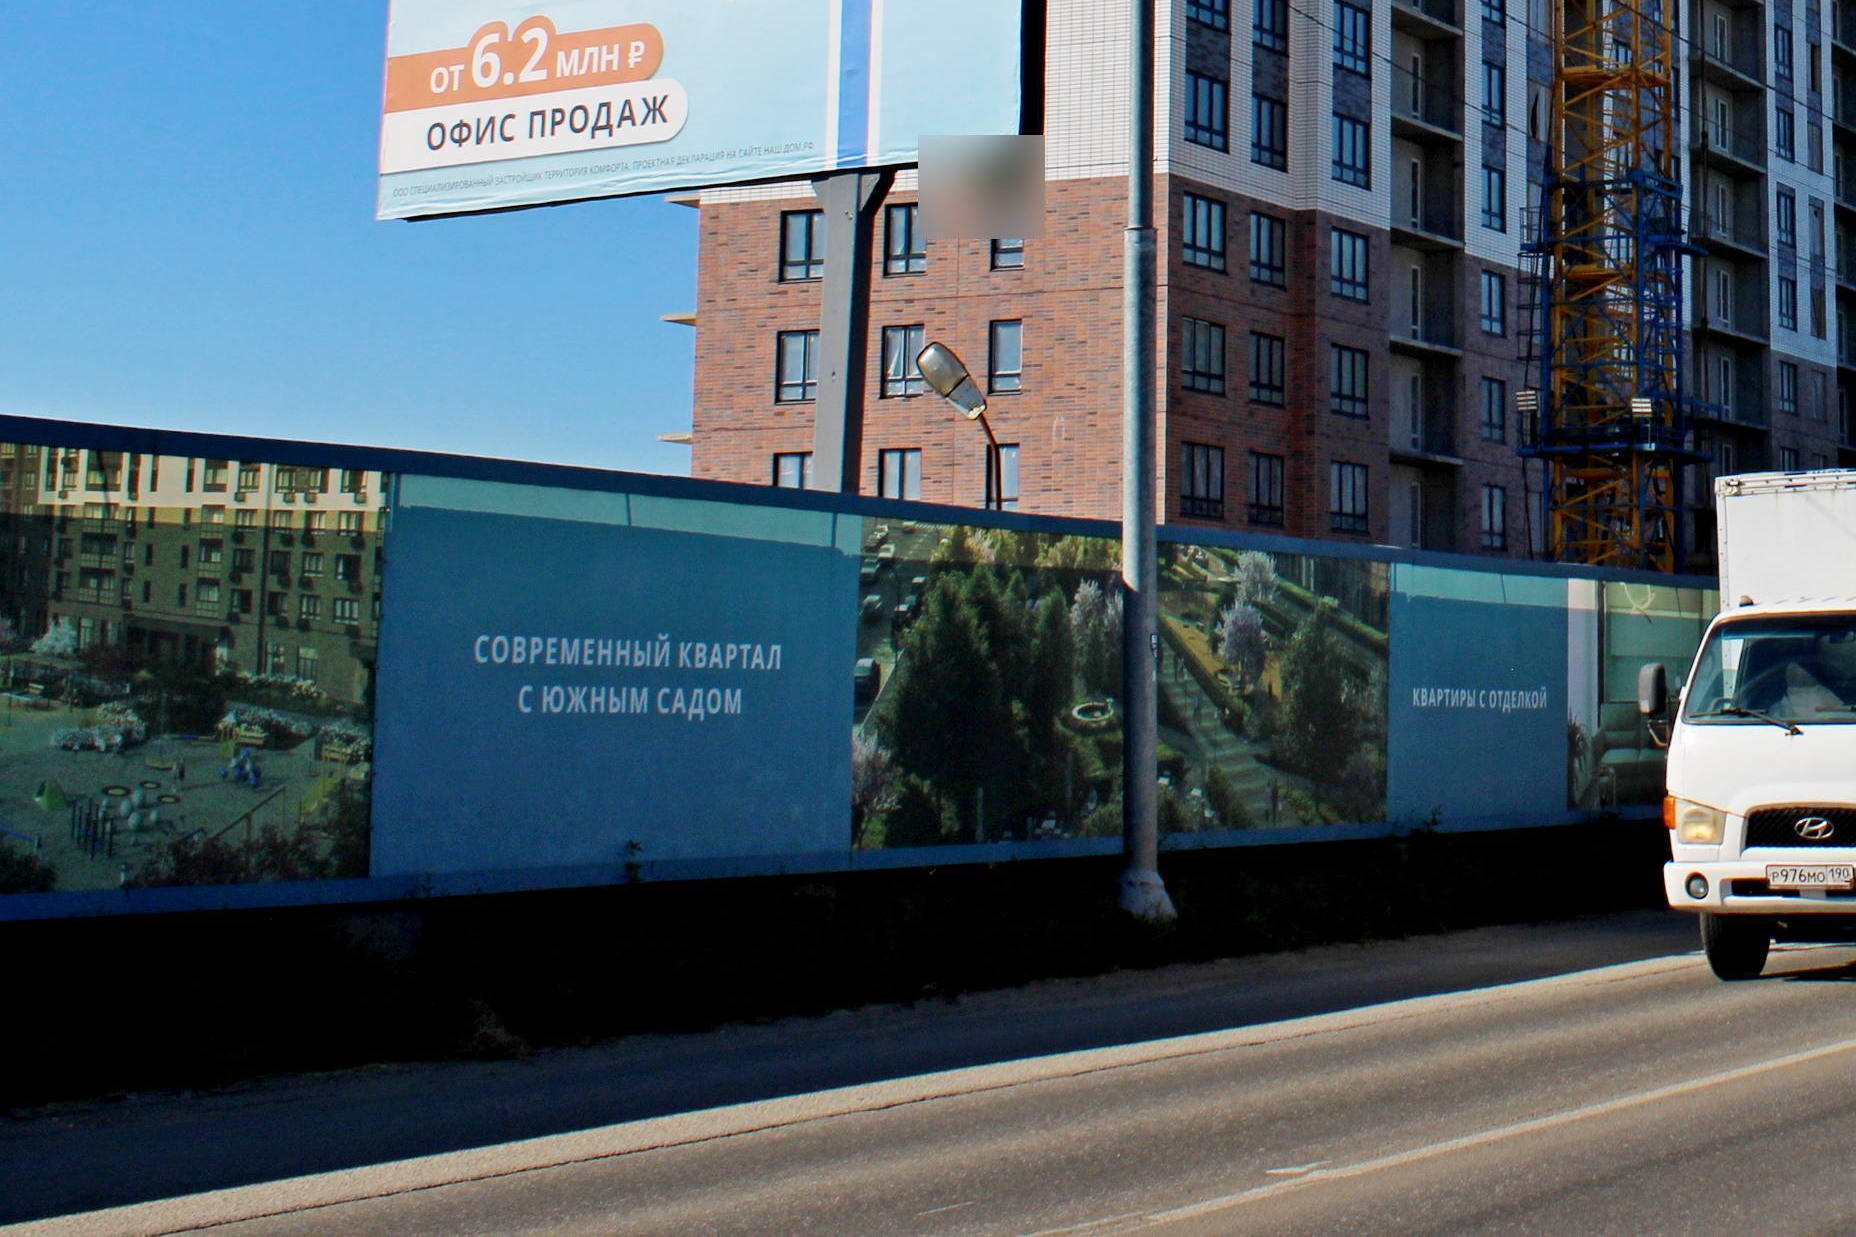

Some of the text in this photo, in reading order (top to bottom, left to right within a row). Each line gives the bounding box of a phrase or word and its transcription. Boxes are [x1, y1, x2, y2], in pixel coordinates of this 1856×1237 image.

[471, 27, 549, 88] 6.2
[555, 43, 620, 78] МЛН
[427, 94, 670, 151] ОФИС ПРОДАЖ
[474, 633, 782, 670] СОВРЕМЕННЫЙ КВАРТАЛ
[518, 684, 742, 721] С ЮЖНЫМ САДОМ
[1412, 685, 1547, 713] КВАРТИРЫ С ОТДЕЛКОЙ
